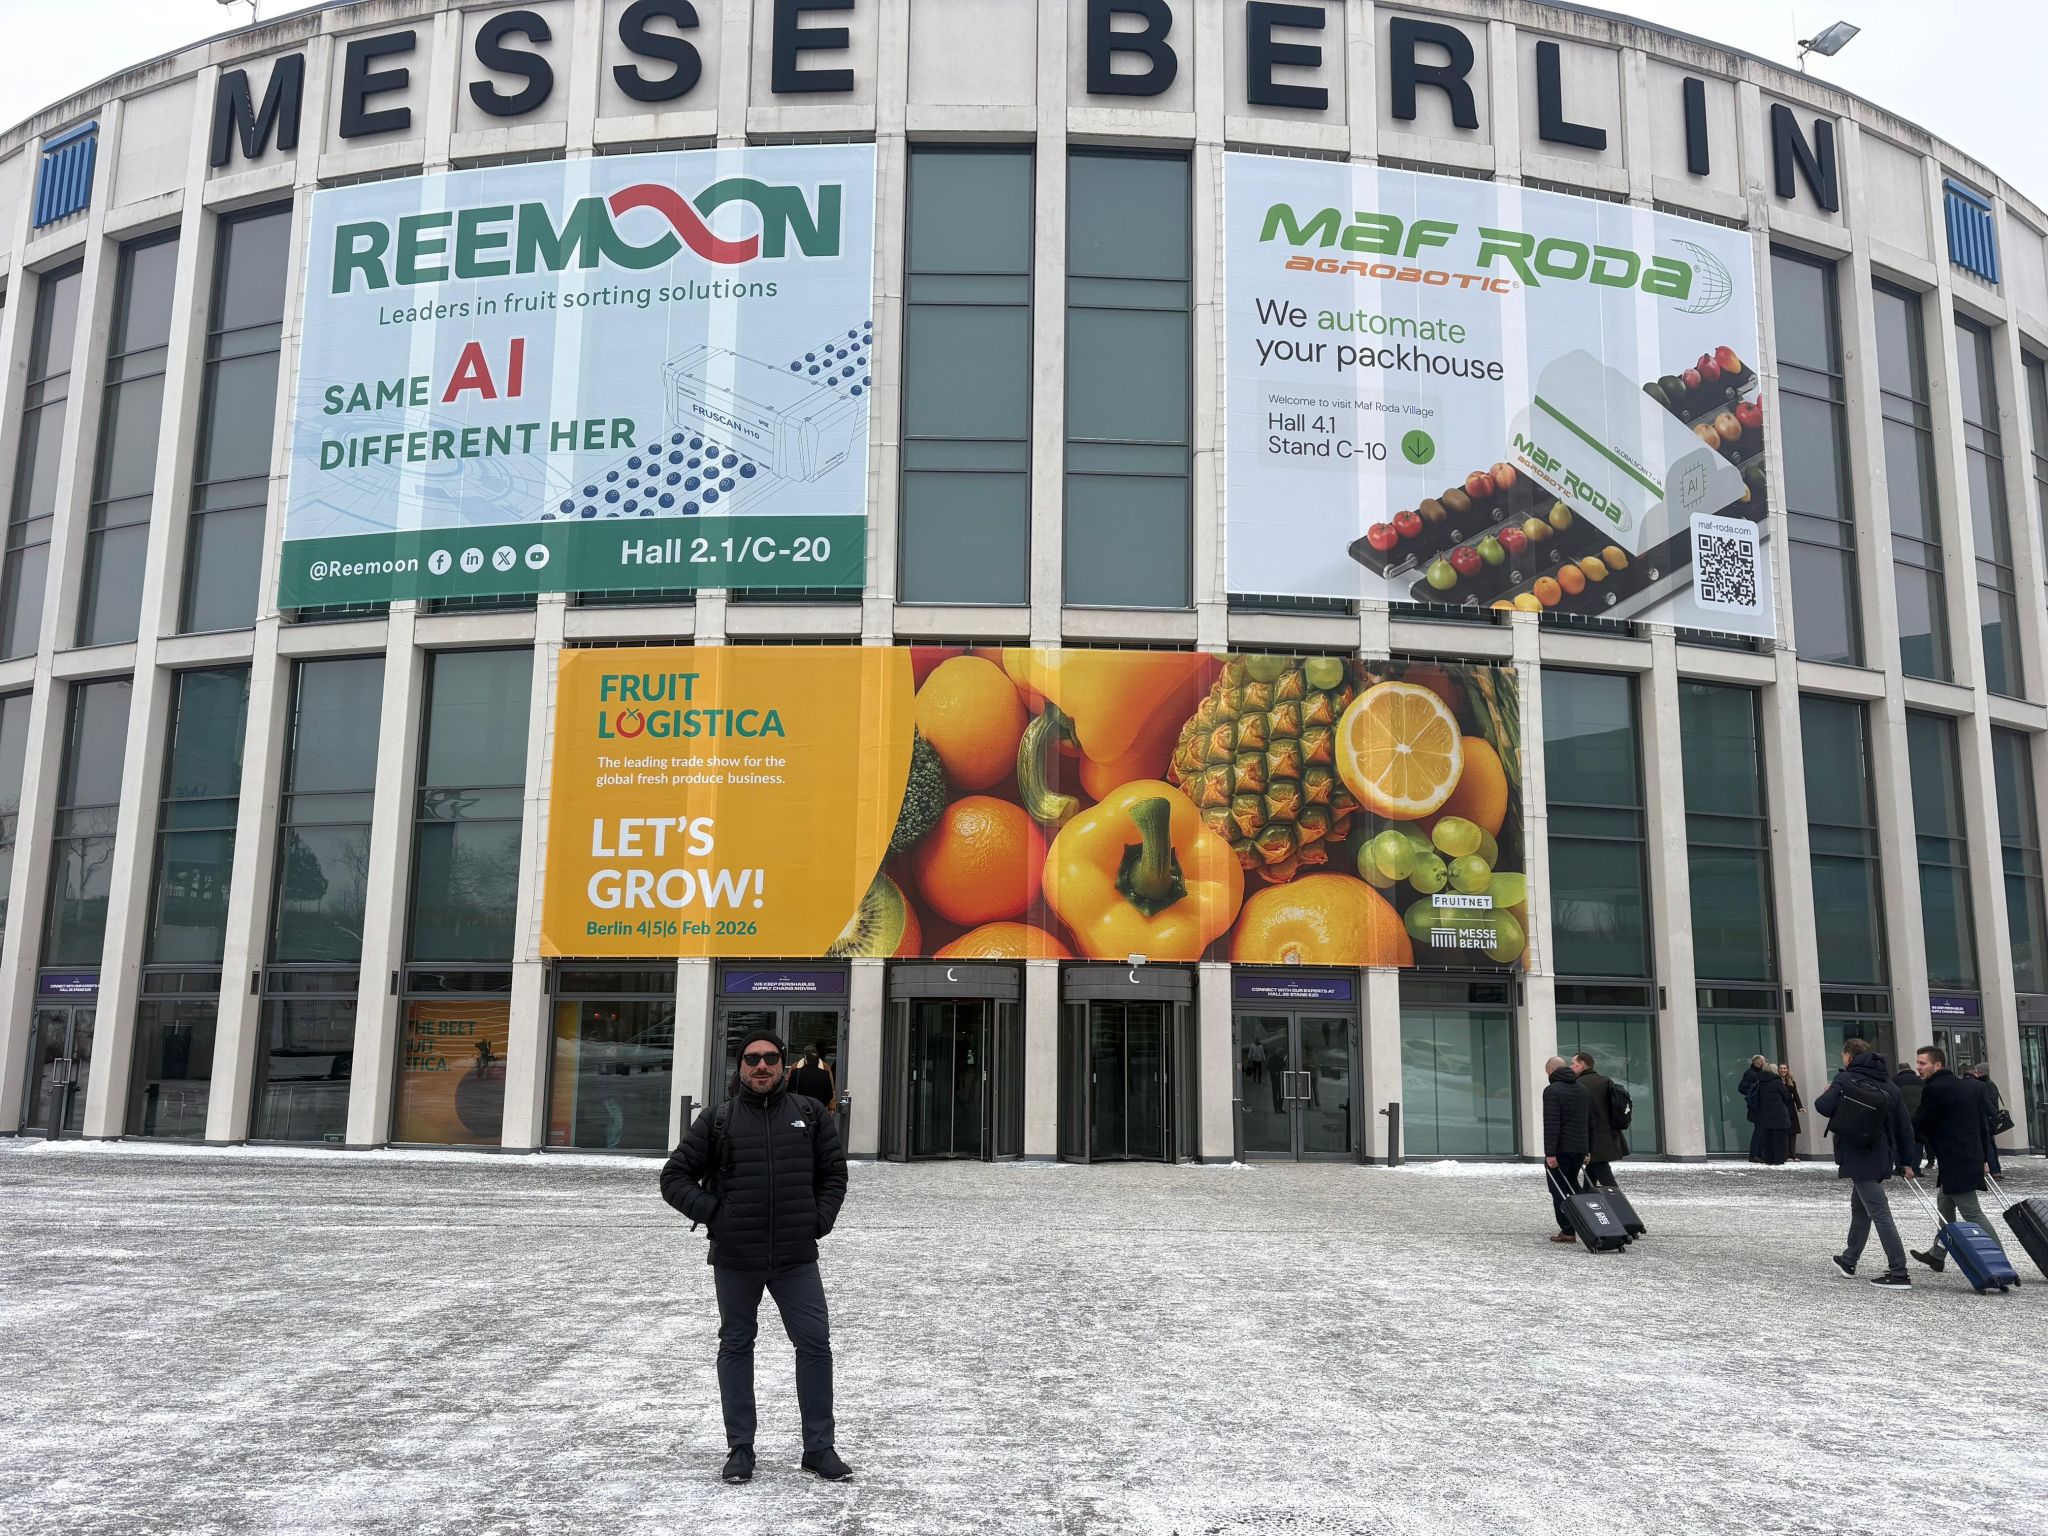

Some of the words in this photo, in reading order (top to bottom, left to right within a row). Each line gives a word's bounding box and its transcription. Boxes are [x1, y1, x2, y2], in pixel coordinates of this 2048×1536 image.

[210, 0, 855, 168] MESSE
[1086, 0, 1839, 213] BERLIN
[331, 177, 843, 295] REEMOON
[379, 297, 470, 326] Leaders
[477, 296, 497, 316] in
[504, 288, 558, 313] fruit
[562, 284, 652, 311] sorting
[658, 277, 778, 303] solutions
[1255, 298, 1307, 328] We
[1317, 309, 1466, 344] automate
[1256, 338, 1327, 367] your
[1337, 343, 1504, 381] packhouse
[322, 375, 430, 416] SAME
[441, 337, 526, 403] AI
[1268, 394, 1316, 407] Welcome
[1319, 399, 1329, 408] to
[1332, 399, 1352, 409] visit
[1355, 400, 1373, 411] Maf
[1375, 402, 1400, 414] Roda
[1402, 404, 1434, 418] Village
[692, 403, 742, 432] FRUSCAN
[743, 426, 760, 440] H10
[1268, 412, 1306, 432] Hall
[1311, 415, 1336, 434] 4.1
[319, 421, 541, 471] DIFFERENT
[549, 417, 637, 453] HER
[1268, 435, 1330, 457] Stand
[1336, 440, 1387, 461] C-10
[1687, 476, 1699, 496] AI
[1697, 520, 1752, 536] maf-roda.com
[620, 538, 682, 566] Hall
[688, 536, 831, 564] 2.1/C-20
[309, 558, 419, 581] @Reemoon
[600, 673, 700, 702] FRUIT
[598, 708, 786, 739] LOGISTICA
[598, 755, 621, 768] The
[623, 755, 668, 769] leading
[671, 755, 704, 768] trade
[707, 755, 740, 768] show
[744, 755, 762, 767] for
[765, 755, 786, 767] the
[596, 773, 634, 788] global
[637, 772, 669, 785] fresh
[672, 772, 724, 787] produce
[727, 772, 786, 785] business.
[591, 815, 715, 857] LET’S
[587, 868, 765, 909] GROW!
[1434, 896, 1491, 907] FRUITNET
[586, 920, 633, 936] Berlin
[682, 920, 711, 936] Feb
[715, 920, 758, 936] 2026
[1459, 928, 1497, 939] MESSE
[1459, 939, 1498, 949] BERLIN
